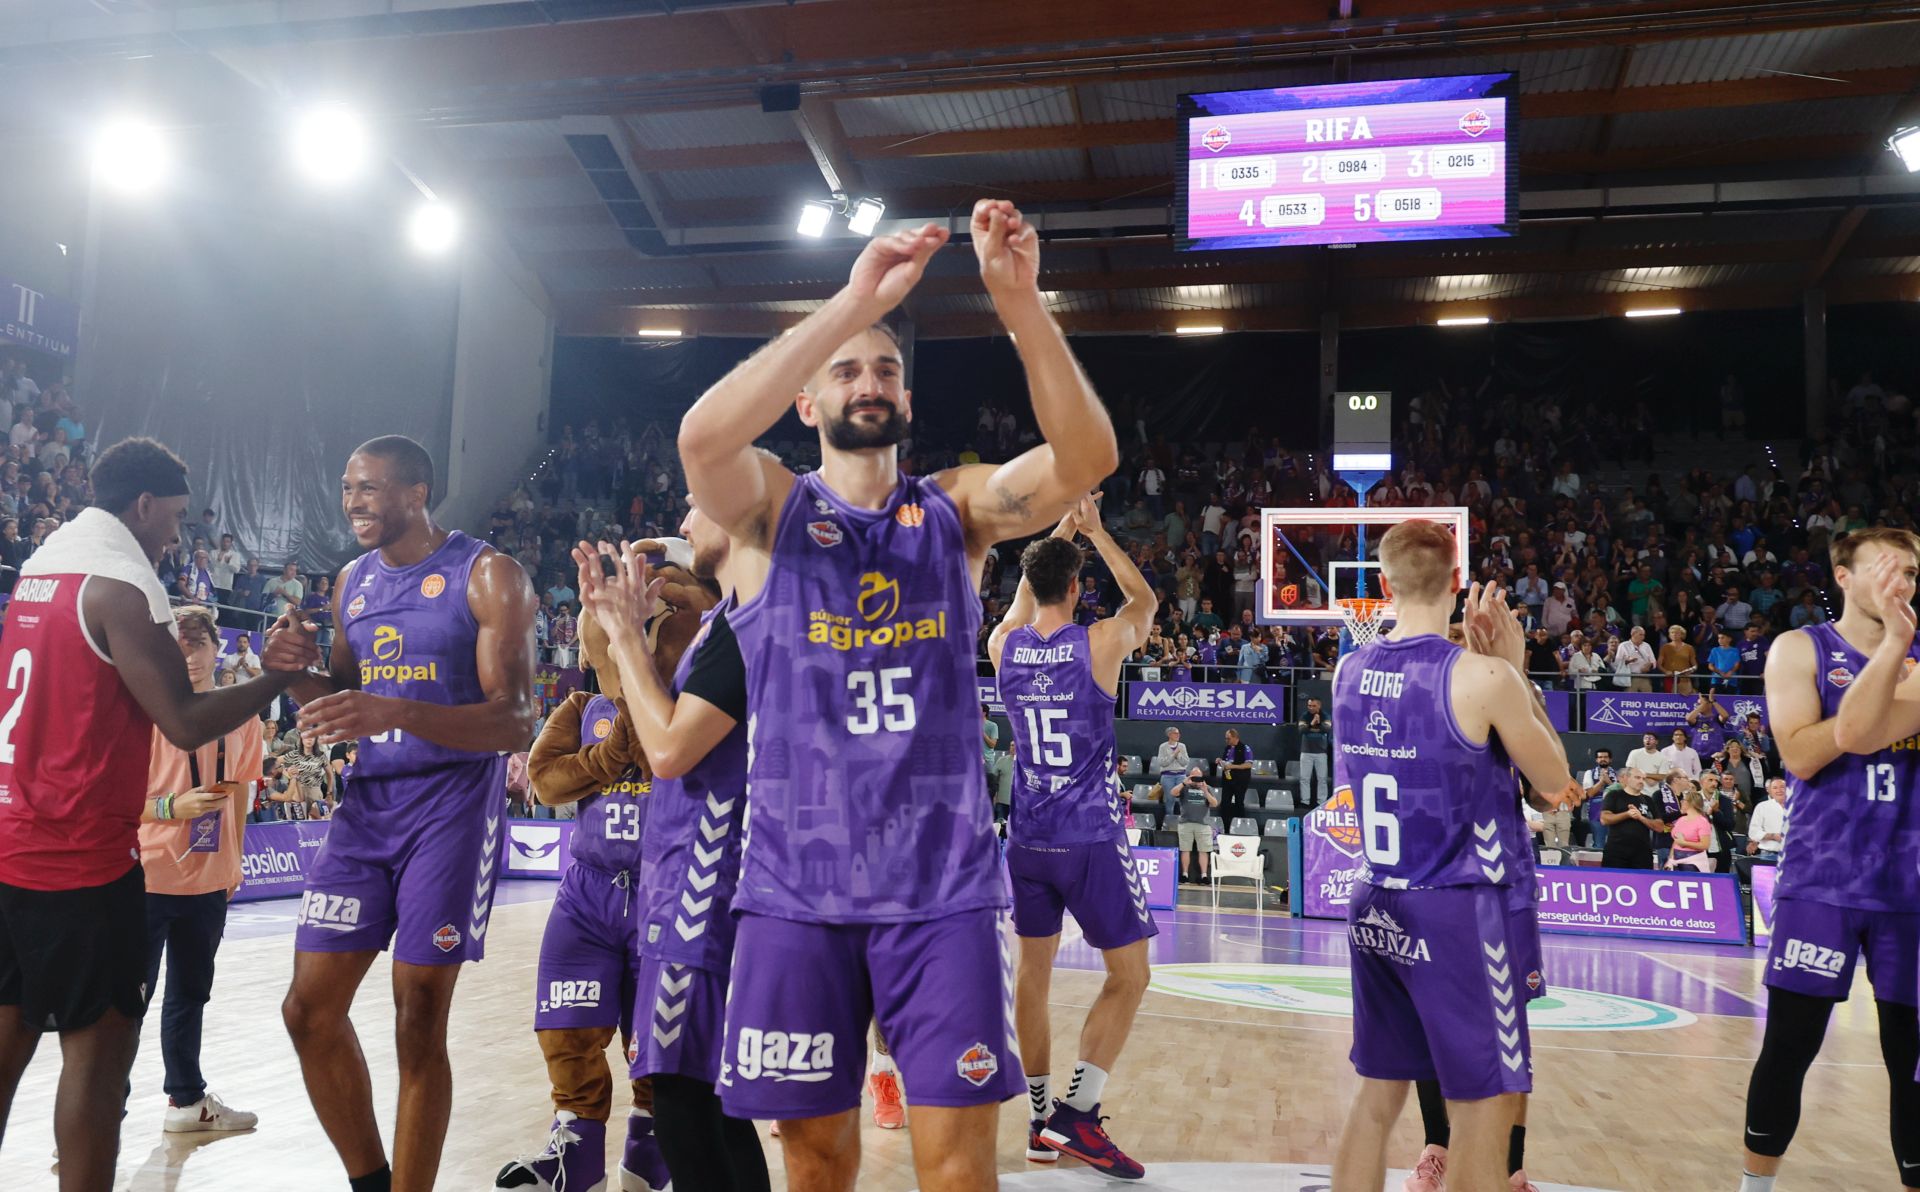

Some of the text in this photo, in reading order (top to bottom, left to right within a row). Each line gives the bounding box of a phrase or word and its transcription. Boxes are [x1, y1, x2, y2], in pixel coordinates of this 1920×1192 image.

[1306, 116, 1373, 142] RIFA
[1200, 150, 1474, 188] 1 0335 2 0984 3 0215
[1238, 193, 1421, 226] 4 0533 5 0518
[1348, 395, 1377, 410] 0.0
[807, 611, 945, 651] agropal
[809, 608, 852, 626] súper
[1012, 644, 1074, 664] GONZALEZ
[361, 662, 437, 685] gropal
[1359, 669, 1404, 698] BORG
[846, 666, 917, 735] 35
[1052, 691, 1074, 701] salud
[1138, 686, 1276, 710] MOESIA
[1621, 700, 1641, 709] FRIO
[1621, 709, 1639, 717] FRIO
[1643, 710, 1648, 718] Y
[1024, 708, 1073, 767] 15
[1391, 745, 1416, 759] salud
[1866, 763, 1896, 802] 13
[605, 803, 640, 841] 23
[1316, 809, 1358, 828] PALE
[1362, 773, 1400, 866] 6
[241, 847, 300, 878] epsilon
[1320, 882, 1353, 899] PALE
[1650, 879, 1714, 911] CFI
[1602, 914, 1610, 925] y
[1613, 913, 1667, 928] Protección
[1670, 916, 1683, 928] de
[1686, 917, 1716, 930] datos
[1348, 924, 1431, 962] EBANZA
[1783, 938, 1846, 972] gaza
[549, 980, 601, 1009] gaza
[737, 1027, 835, 1080] gaza
